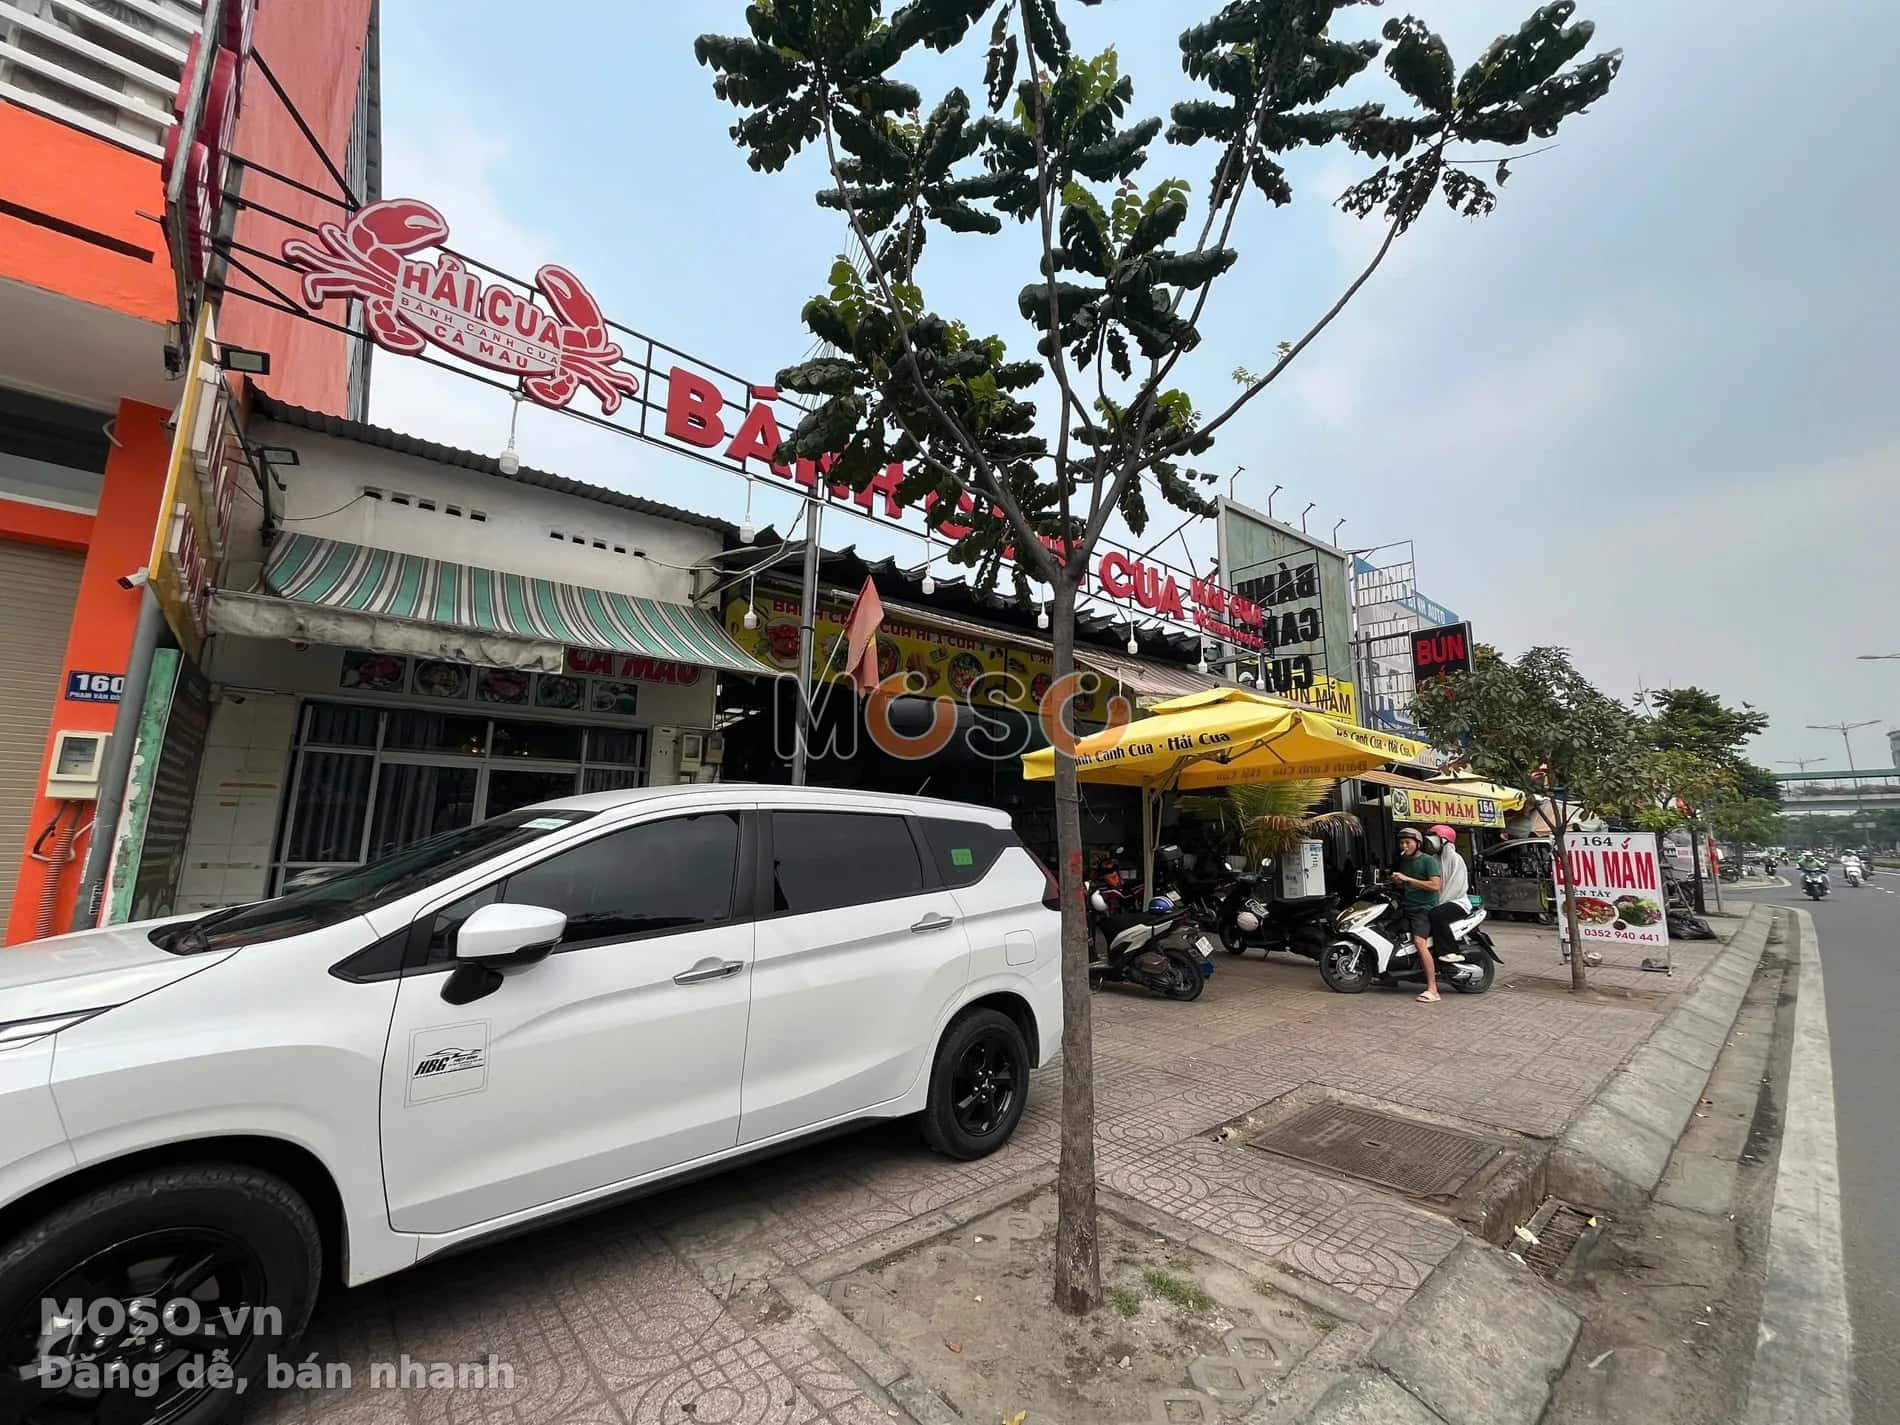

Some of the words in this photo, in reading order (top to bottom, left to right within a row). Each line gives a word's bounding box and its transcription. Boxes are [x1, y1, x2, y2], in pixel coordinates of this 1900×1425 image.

[402, 258, 474, 313] HẢI
[486, 289, 560, 348] CUA
[467, 321, 514, 348] CANH
[527, 346, 559, 365] CUA
[480, 342, 528, 370] MAU
[1100, 551, 1185, 621] CUA
[1416, 630, 1465, 667] BÚN
[76, 674, 125, 694] 160
[620, 658, 701, 687] MAU
[1096, 746, 1125, 762] Canh
[1128, 743, 1154, 757] Cua
[1198, 731, 1231, 745] Cua
[1412, 794, 1441, 816] BÚN
[1445, 794, 1475, 819] MẮM
[1478, 800, 1494, 813] 164
[1582, 836, 1613, 847] 164
[1602, 836, 1656, 890] MẮM
[1584, 928, 1611, 938] 0352
[1615, 930, 1636, 940] 940
[1639, 932, 1660, 942] 441
[414, 1056, 450, 1076] HBG
